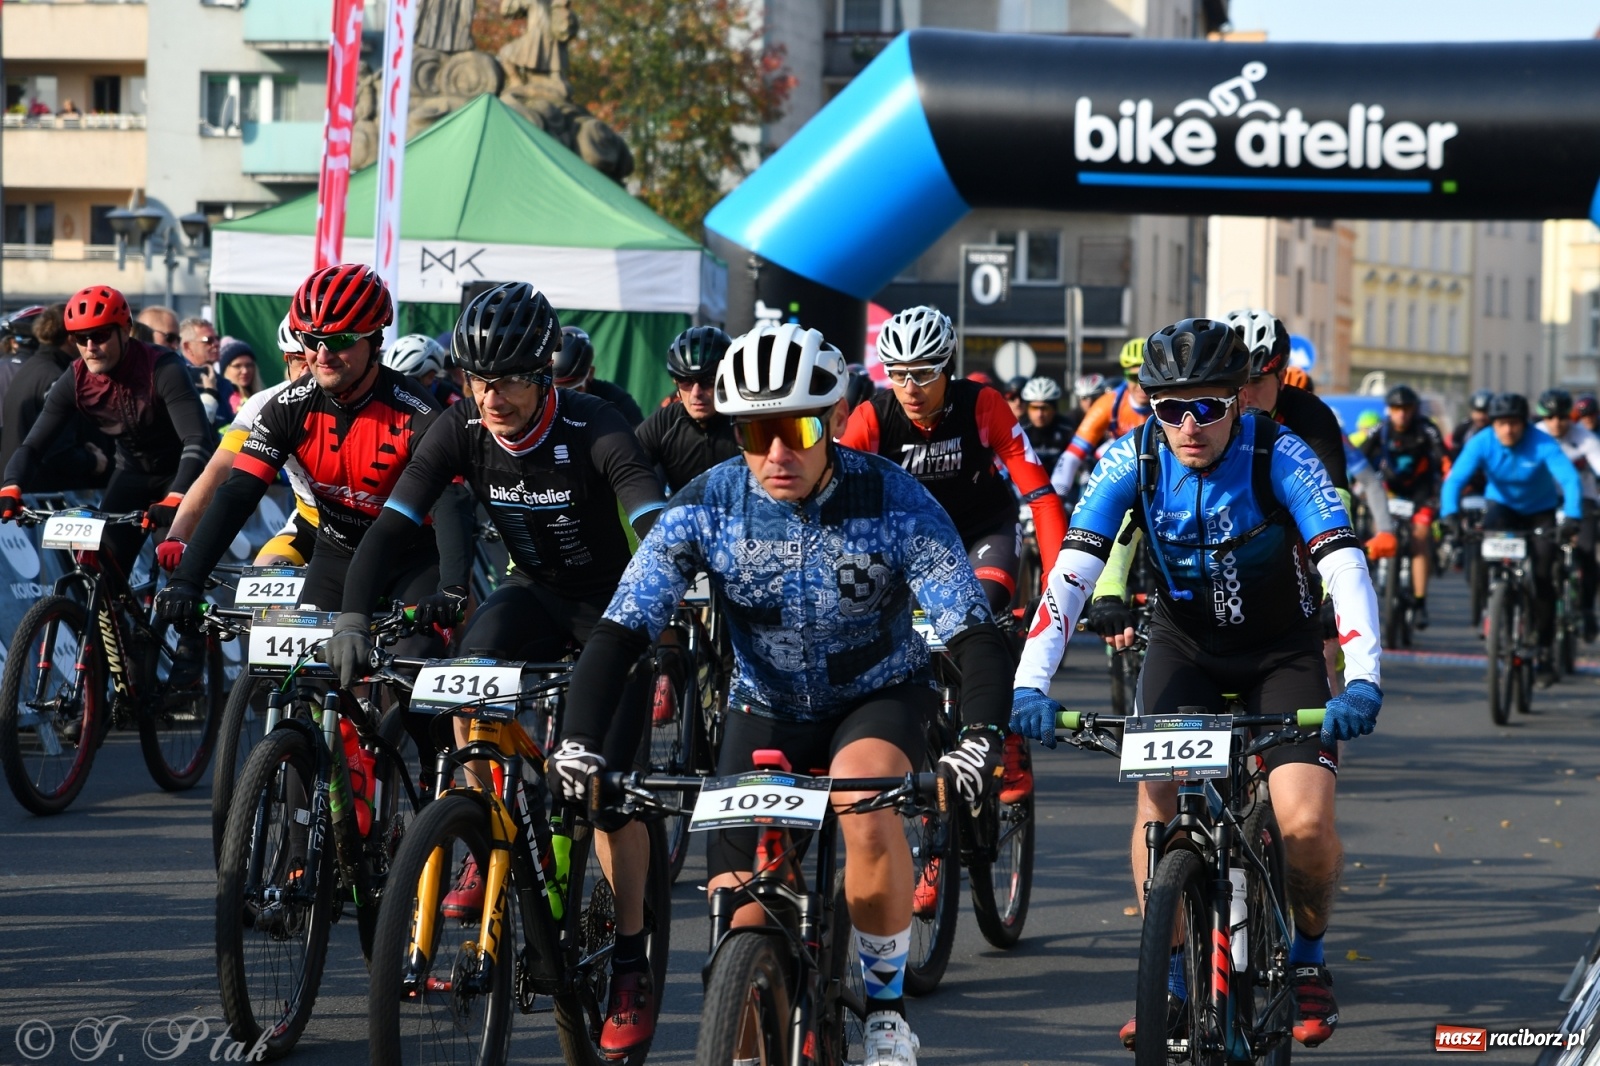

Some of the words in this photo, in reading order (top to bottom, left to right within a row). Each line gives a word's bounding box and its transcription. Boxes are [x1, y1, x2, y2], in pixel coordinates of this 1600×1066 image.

[1074, 96, 1217, 166] bike
[1235, 102, 1459, 170] atelier
[971, 264, 1002, 305] 0
[489, 485, 520, 502] bike
[523, 489, 572, 505] atelier
[53, 523, 93, 537] 2978
[247, 582, 296, 597] 2421
[98, 597, 129, 697] S-WORK
[266, 635, 312, 657] 141
[432, 674, 500, 699] 1316
[1143, 739, 1214, 761] 1162
[718, 793, 804, 812] 1099
